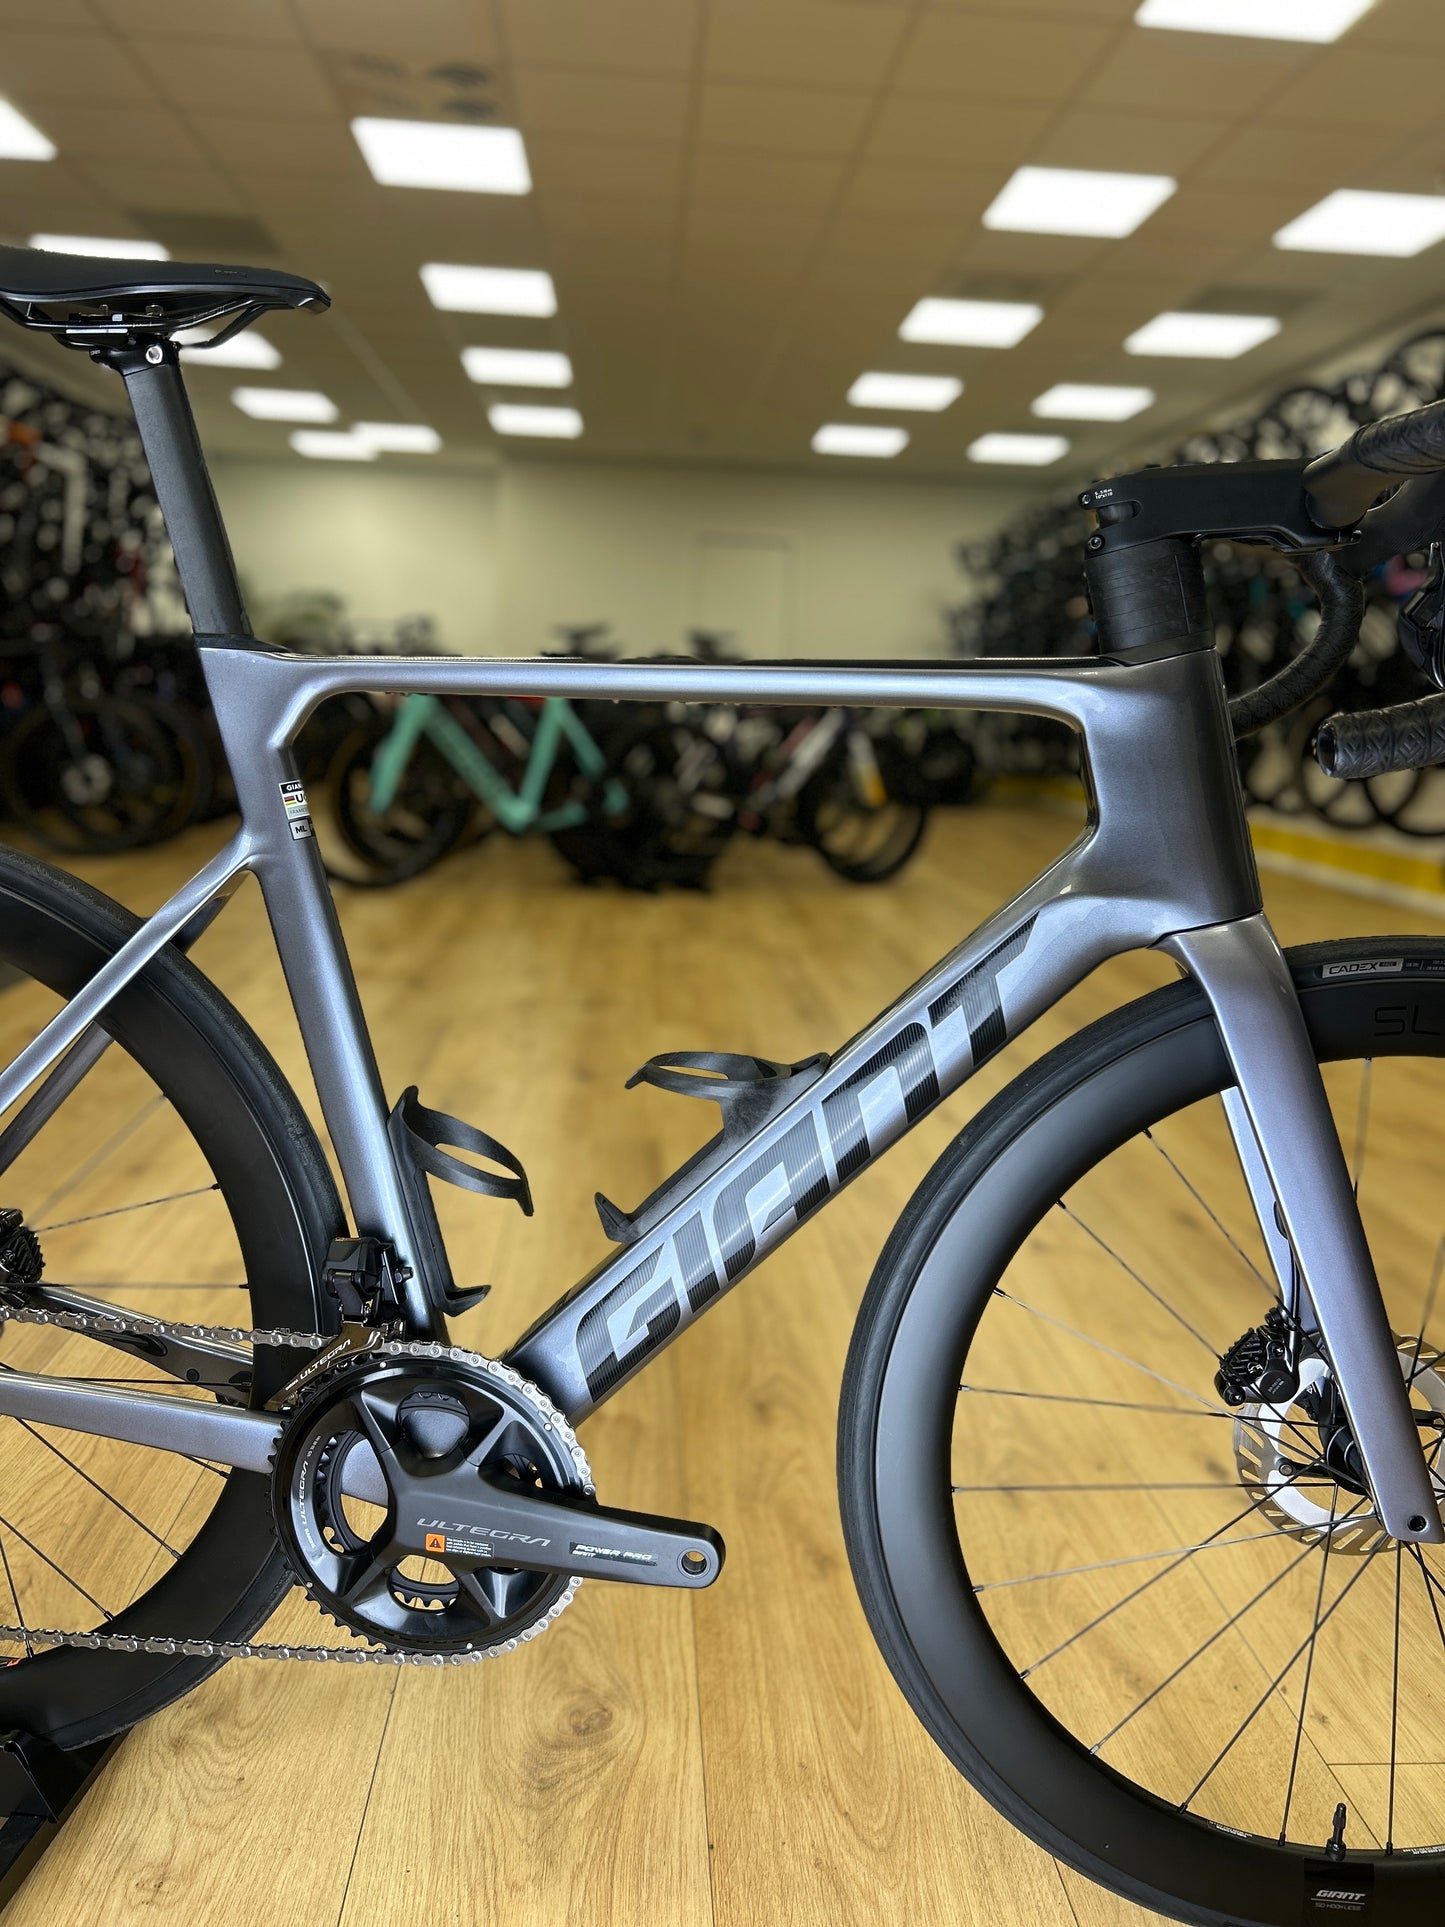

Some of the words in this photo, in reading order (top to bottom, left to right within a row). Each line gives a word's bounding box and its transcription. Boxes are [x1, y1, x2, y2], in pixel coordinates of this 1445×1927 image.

[295, 825, 308, 834] ML
[1329, 962, 1378, 975] CADEX
[575, 911, 1040, 1403] GIANT
[300, 1338, 351, 1380] ULTEGRA
[294, 1460, 310, 1525] ULTEGRA
[416, 1518, 551, 1548] ULTEGRA
[575, 1544, 621, 1557] POWER
[622, 1551, 653, 1561] PRO
[1315, 1889, 1366, 1901] GIANT
